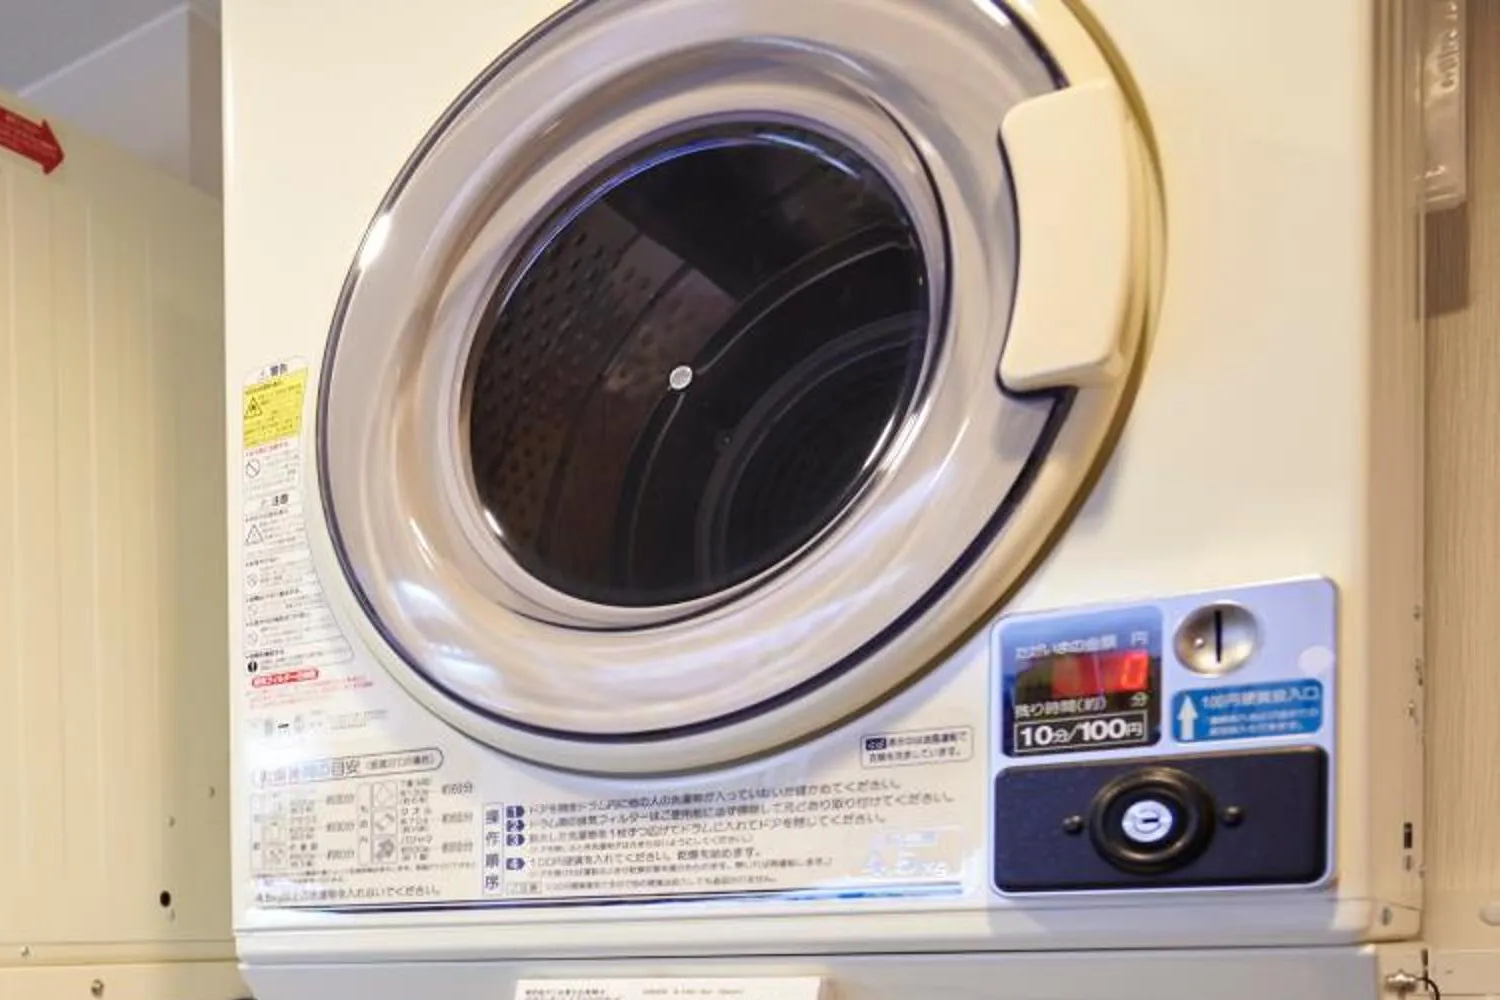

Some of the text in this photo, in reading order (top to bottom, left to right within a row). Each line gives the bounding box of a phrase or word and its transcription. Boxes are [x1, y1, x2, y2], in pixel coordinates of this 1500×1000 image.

[1121, 651, 1148, 688] 0
[1020, 718, 1144, 747] 10分/100円
[485, 809, 500, 891] 操作順序
